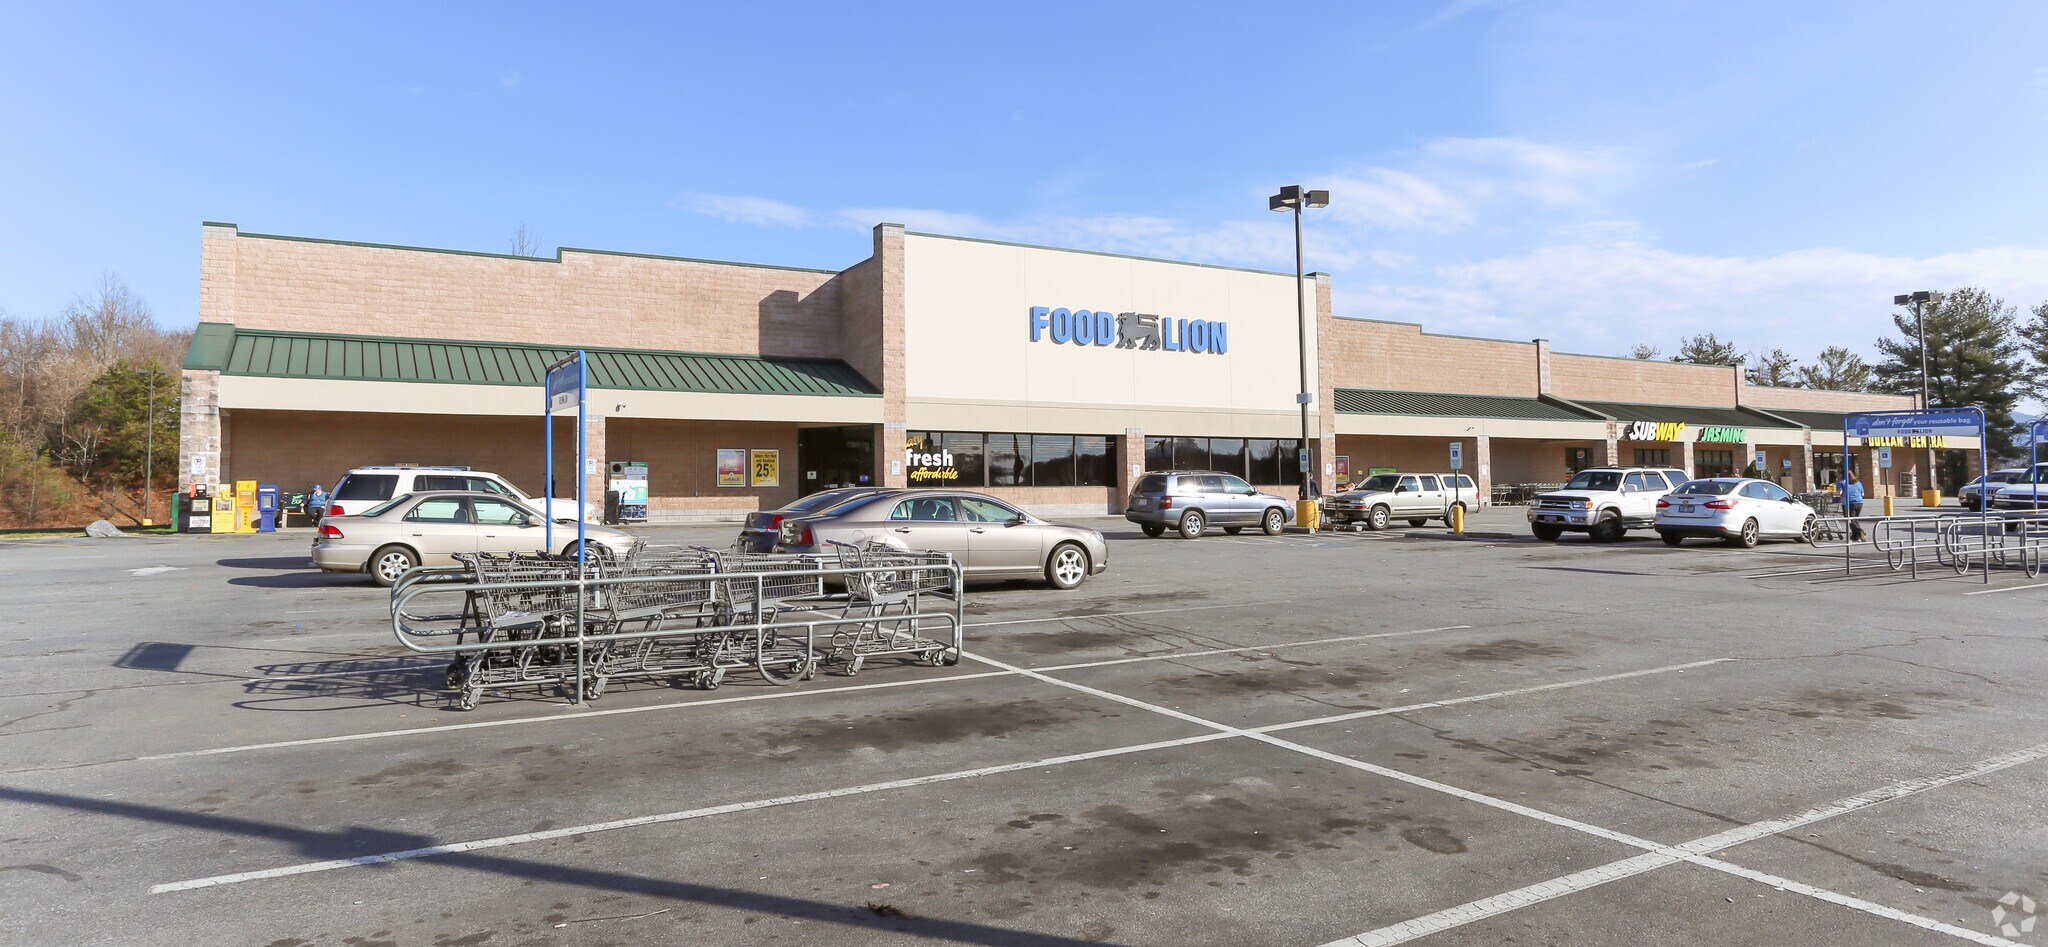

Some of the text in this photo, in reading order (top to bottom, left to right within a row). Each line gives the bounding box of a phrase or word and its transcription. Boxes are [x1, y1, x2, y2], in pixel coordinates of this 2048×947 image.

[1029, 306, 1227, 354] FOOD LION
[1872, 418, 1891, 426] don't
[1892, 416, 1914, 427] forget
[1630, 421, 1686, 441] SUBWAY
[906, 435, 923, 449] asy
[1910, 435, 1946, 448] GENRAL
[906, 448, 953, 466] fresh
[910, 467, 958, 481] affordable
